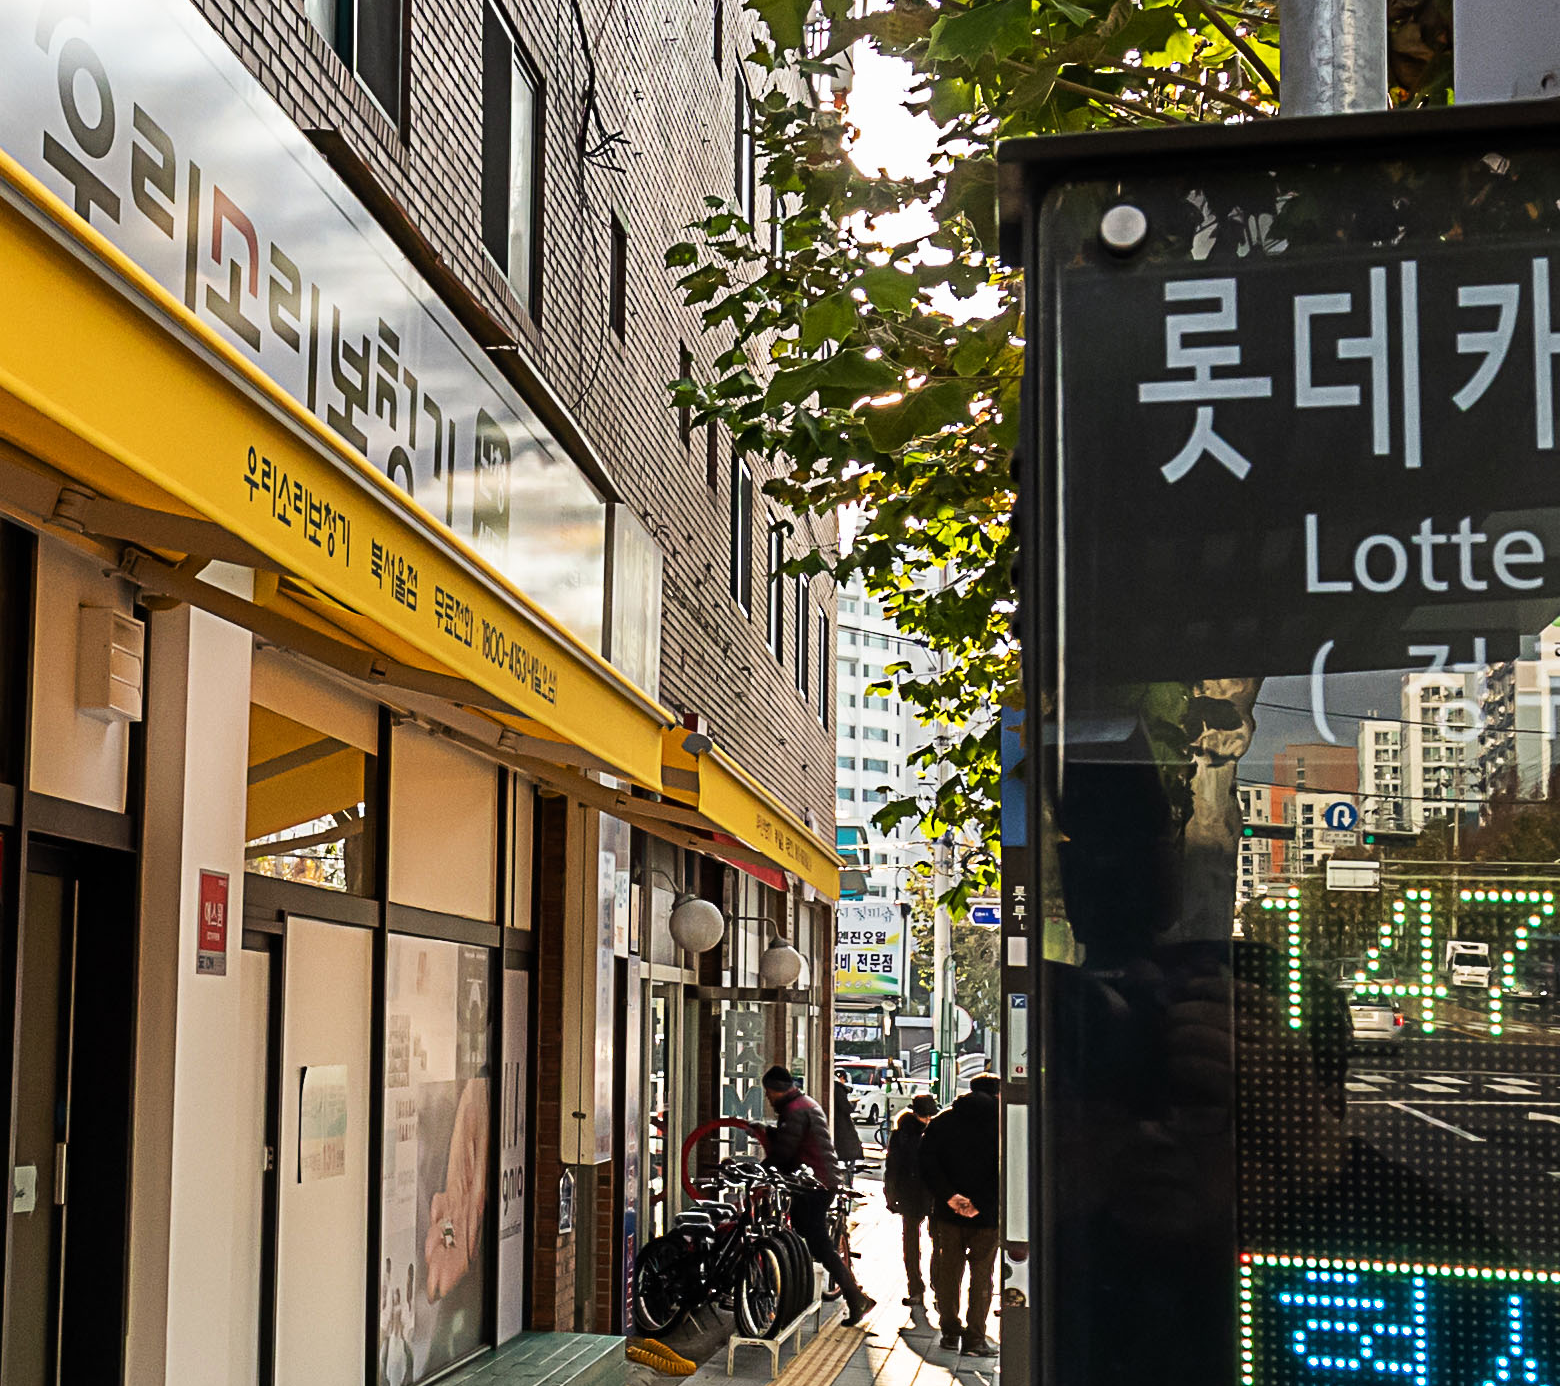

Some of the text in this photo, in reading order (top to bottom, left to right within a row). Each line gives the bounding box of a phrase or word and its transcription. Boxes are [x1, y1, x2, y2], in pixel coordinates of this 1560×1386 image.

[243, 445, 351, 568] 우리소리보청기
[371, 537, 418, 612] 북서울점
[1303, 511, 1546, 596] Lotte
[856, 953, 893, 973] 전문점
[1258, 891, 1558, 1037] 147
